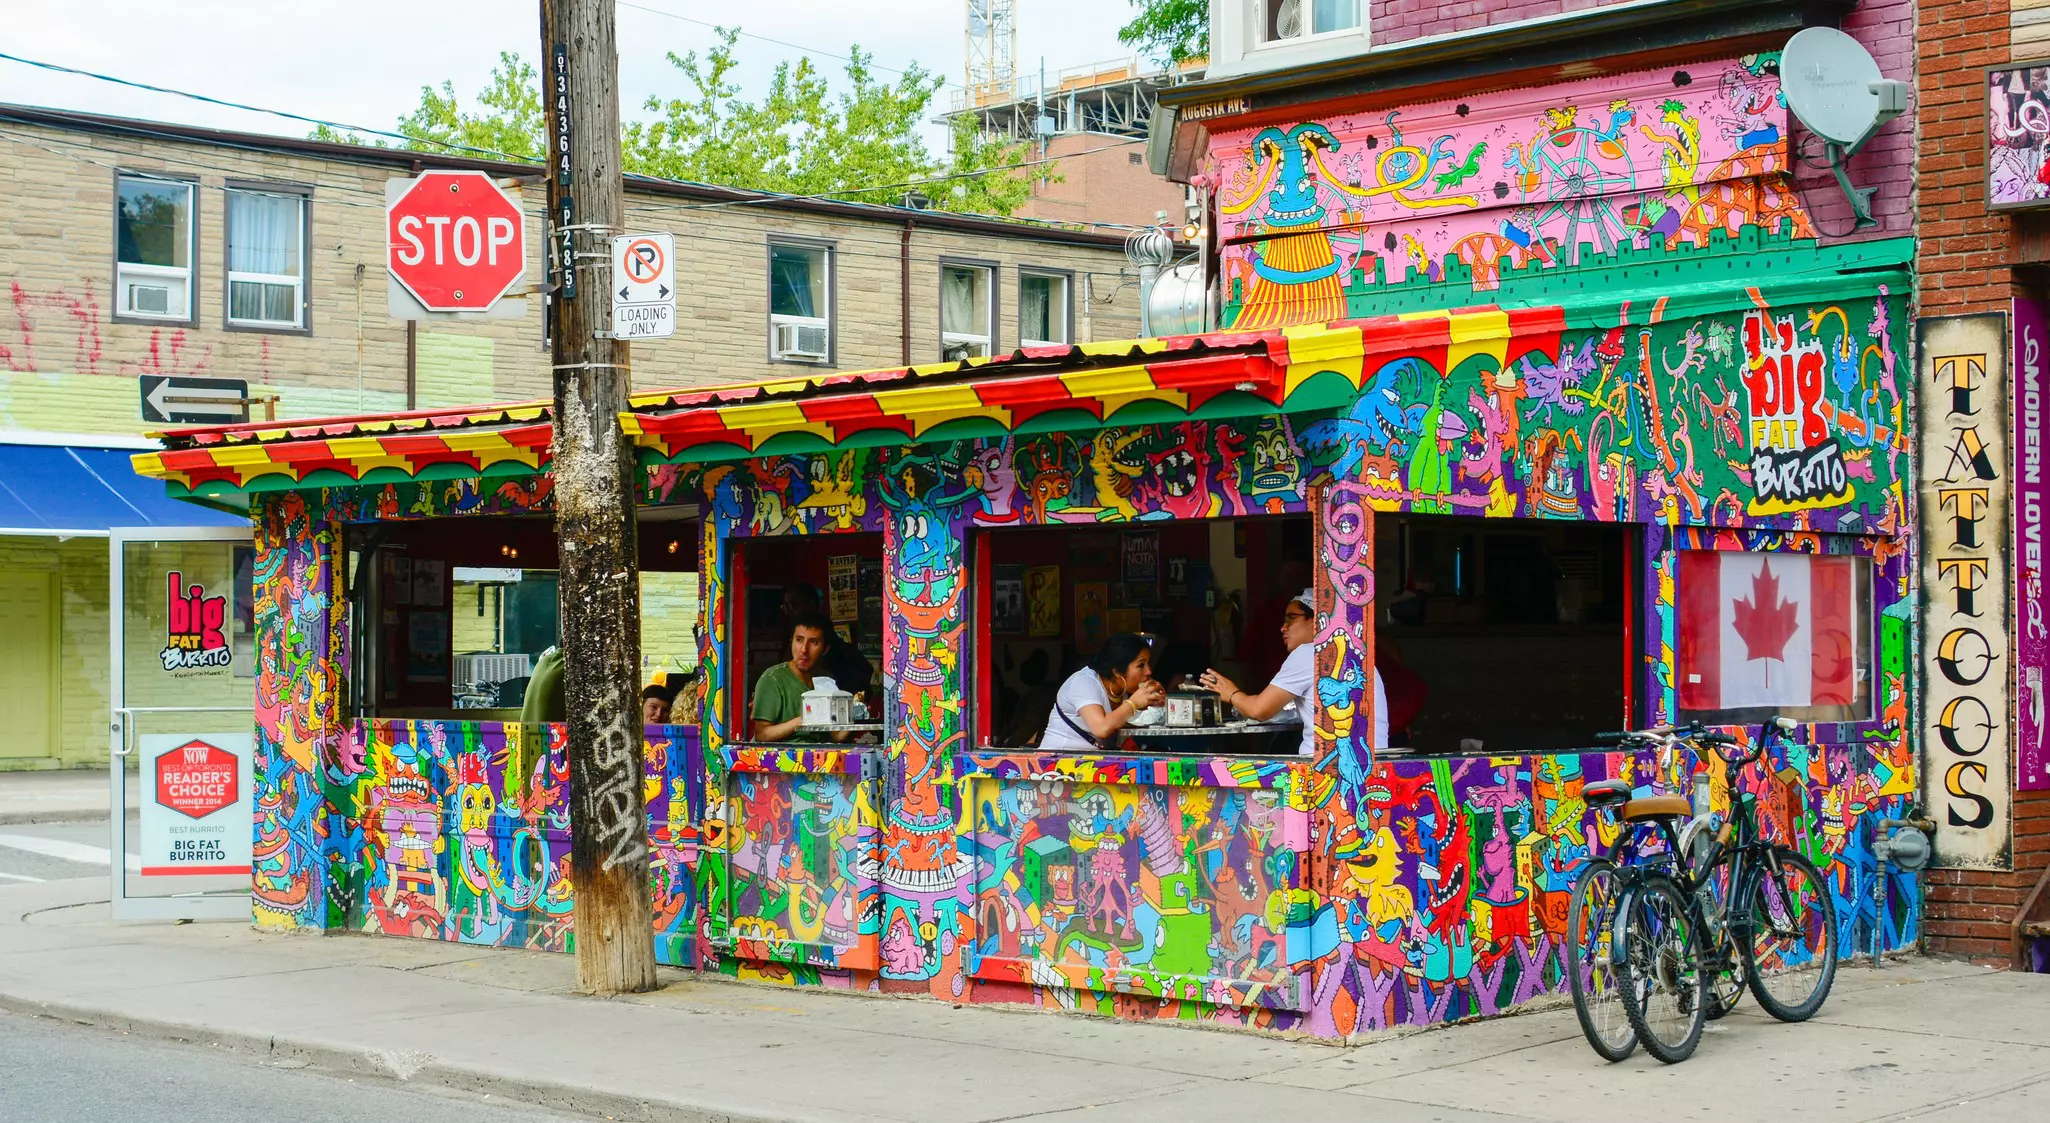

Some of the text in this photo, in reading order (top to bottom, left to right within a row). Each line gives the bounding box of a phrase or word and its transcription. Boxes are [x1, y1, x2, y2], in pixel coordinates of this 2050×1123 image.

[1181, 103, 1225, 121] AUGUSTA
[397, 215, 515, 267] STOP
[620, 306, 667, 322] LOADING
[631, 322, 657, 335] ONLY
[1741, 316, 1828, 449] big
[2024, 364, 2041, 484] MODERN
[1751, 419, 1798, 450] FAT
[1751, 443, 1846, 500] BURRITO
[830, 557, 856, 566] WANTED
[1931, 353, 2000, 830] TATTOOS
[168, 571, 227, 651] big
[169, 635, 201, 649] FAT
[160, 646, 231, 670] BURRITO
[183, 747, 209, 765] NOW
[162, 763, 232, 772] BEST OF TORONTO
[163, 772, 232, 784] READER'S
[169, 784, 225, 796] CHOICE
[169, 825, 225, 834] BEST BURRITO
[174, 840, 221, 850] BIG FAT
[169, 850, 226, 861] BURRITO
